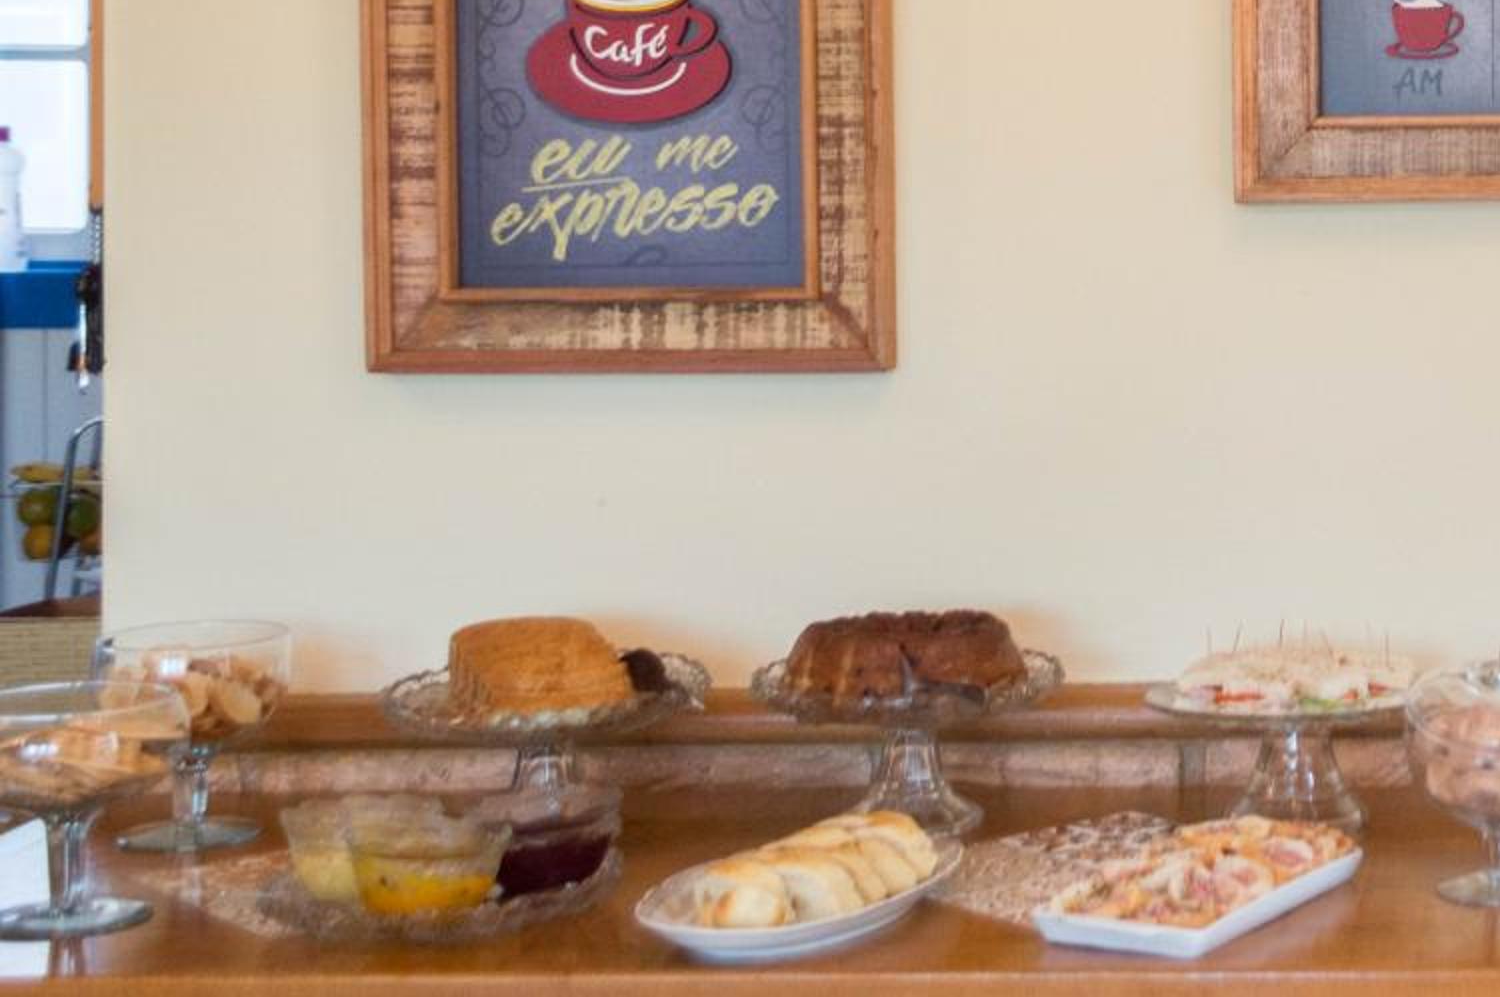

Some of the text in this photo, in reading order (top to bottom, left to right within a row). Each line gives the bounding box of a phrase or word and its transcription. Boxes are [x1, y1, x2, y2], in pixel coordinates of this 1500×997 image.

[584, 24, 670, 66] Café
[1393, 67, 1443, 96] AM
[531, 134, 739, 184] eu me
[491, 176, 779, 261] expresso
